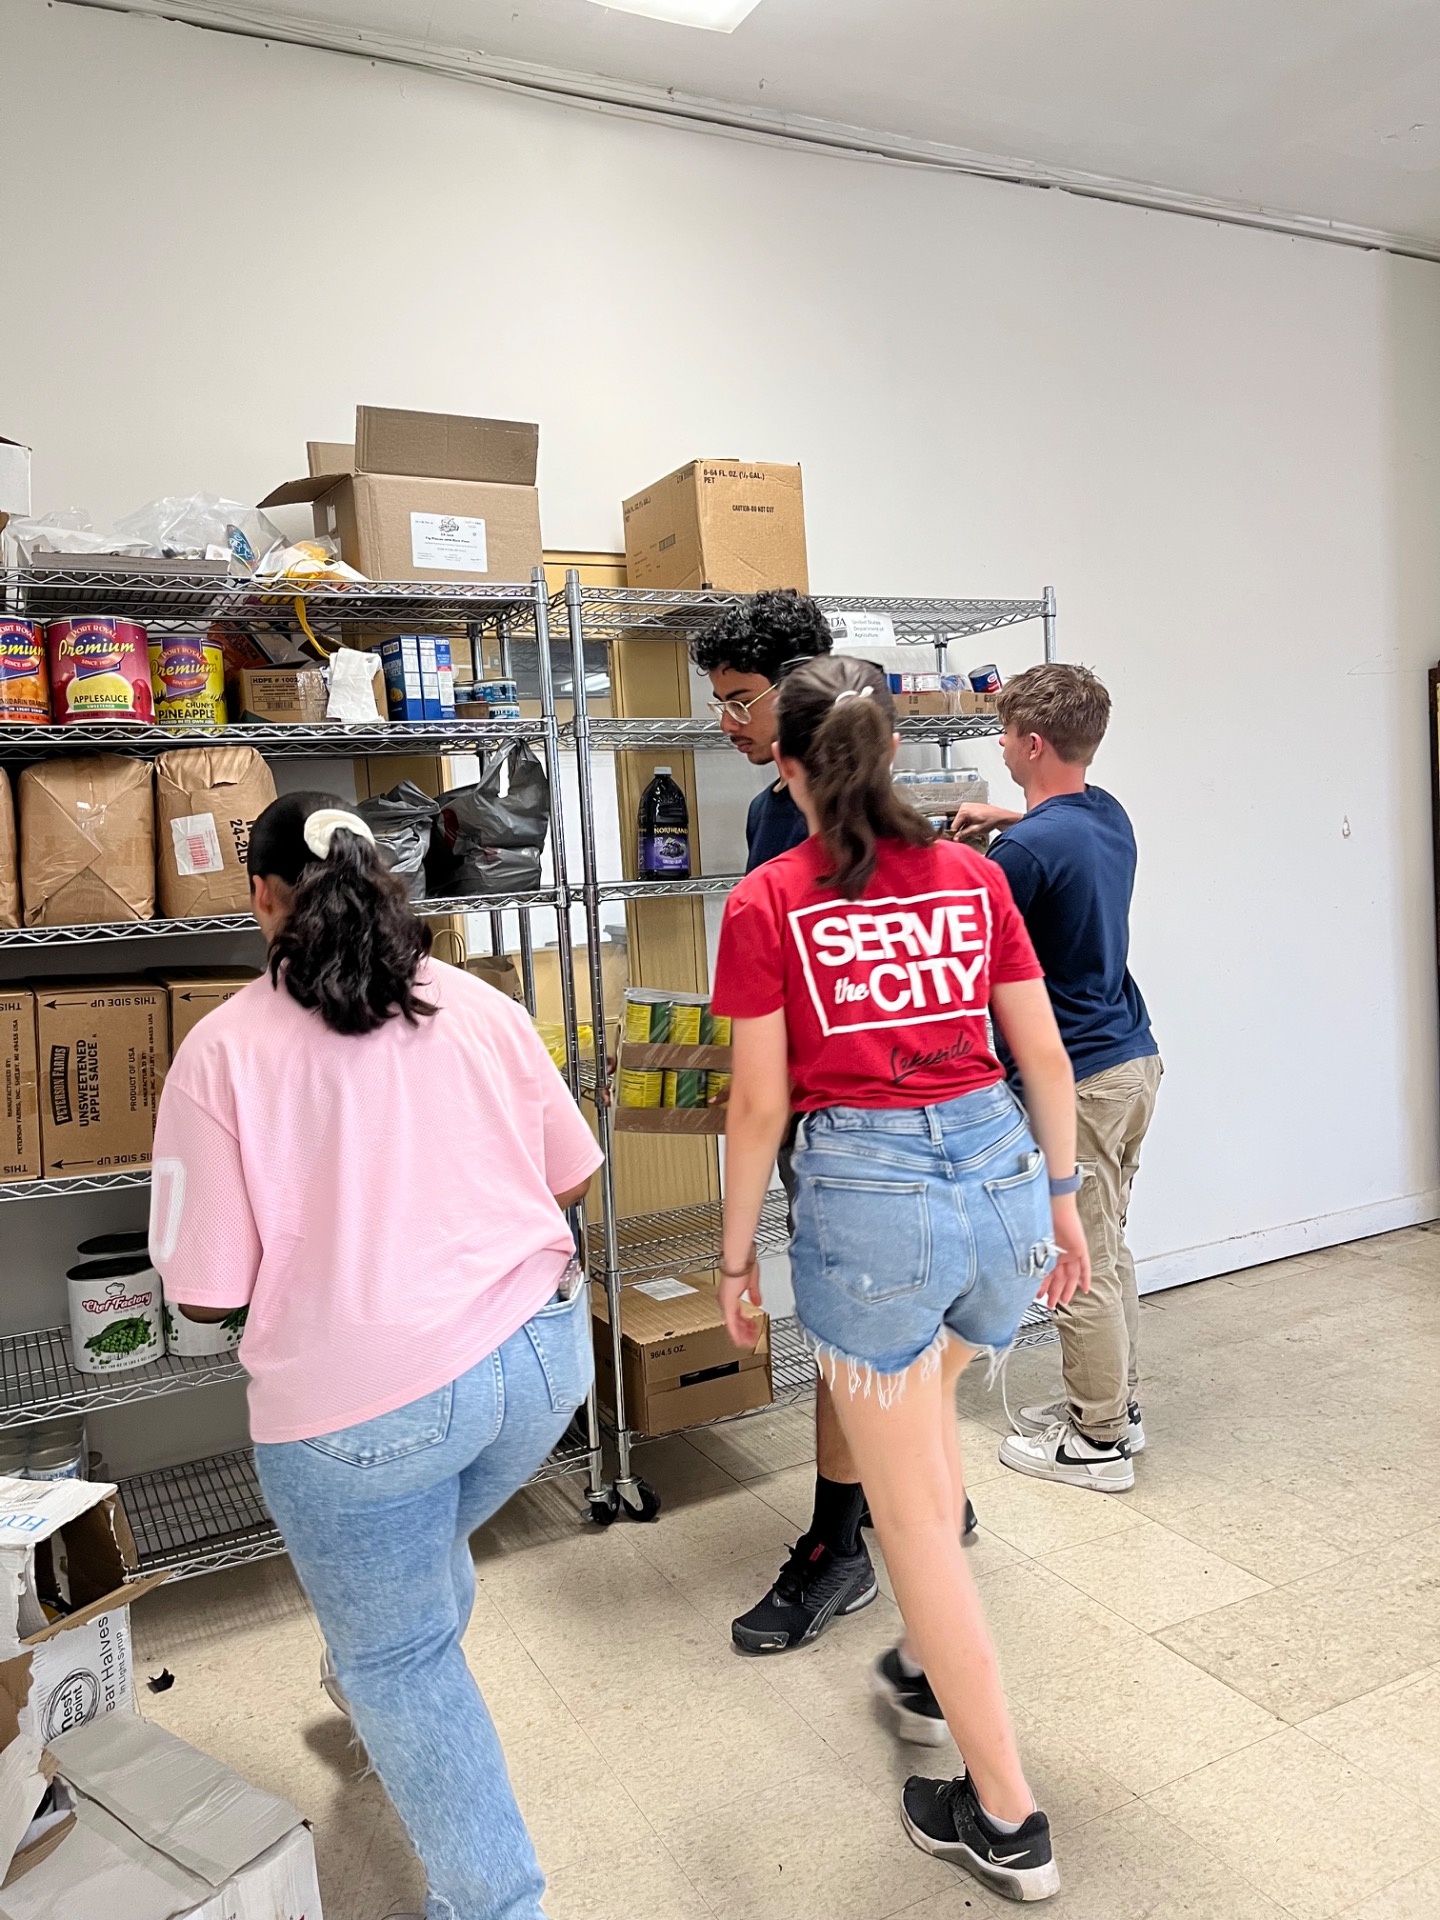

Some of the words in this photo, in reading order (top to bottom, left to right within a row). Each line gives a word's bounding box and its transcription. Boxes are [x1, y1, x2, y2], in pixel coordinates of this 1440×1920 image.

[0, 625, 14, 633] ORT
[70, 625, 91, 638] PORT
[93, 625, 117, 639] ROYAL
[0, 643, 45, 656] emium
[58, 639, 135, 661] Premium
[161, 647, 181, 658] PORT
[181, 647, 202, 660] ROYAL
[151, 660, 217, 677] Premium
[74, 694, 128, 704] APPLESAUCE
[158, 709, 215, 719] PINEAPPLE
[811, 905, 984, 967] SERVE
[834, 976, 870, 1005] the
[869, 955, 984, 1012] CITY
[91, 999, 104, 1008] UP
[108, 998, 131, 1007] SIDE
[134, 997, 156, 1006] THIS
[52, 1047, 66, 1077] FARMS
[87, 1042, 98, 1081] SAUCE
[890, 1031, 974, 1084] Lakeside
[129, 1064, 136, 1074] OF
[76, 1039, 89, 1127] UNSWEETENED
[129, 1076, 137, 1111] PRODUCT
[53, 1078, 69, 1122] PETERSON
[89, 1084, 100, 1122] APPLE
[97, 1156, 110, 1165] UP
[114, 1154, 137, 1163] SIDE
[140, 1152, 152, 1161] IS
[4, 1164, 28, 1174] THIS
[82, 1299, 112, 1314] Chef
[111, 1291, 152, 1310] Factory
[98, 1616, 114, 1682] Halves
[115, 1631, 125, 1660] Syrup
[118, 1660, 127, 1685] Light
[72, 1684, 86, 1723] point
[105, 1684, 115, 1712] ear
[61, 1690, 74, 1733] nest
